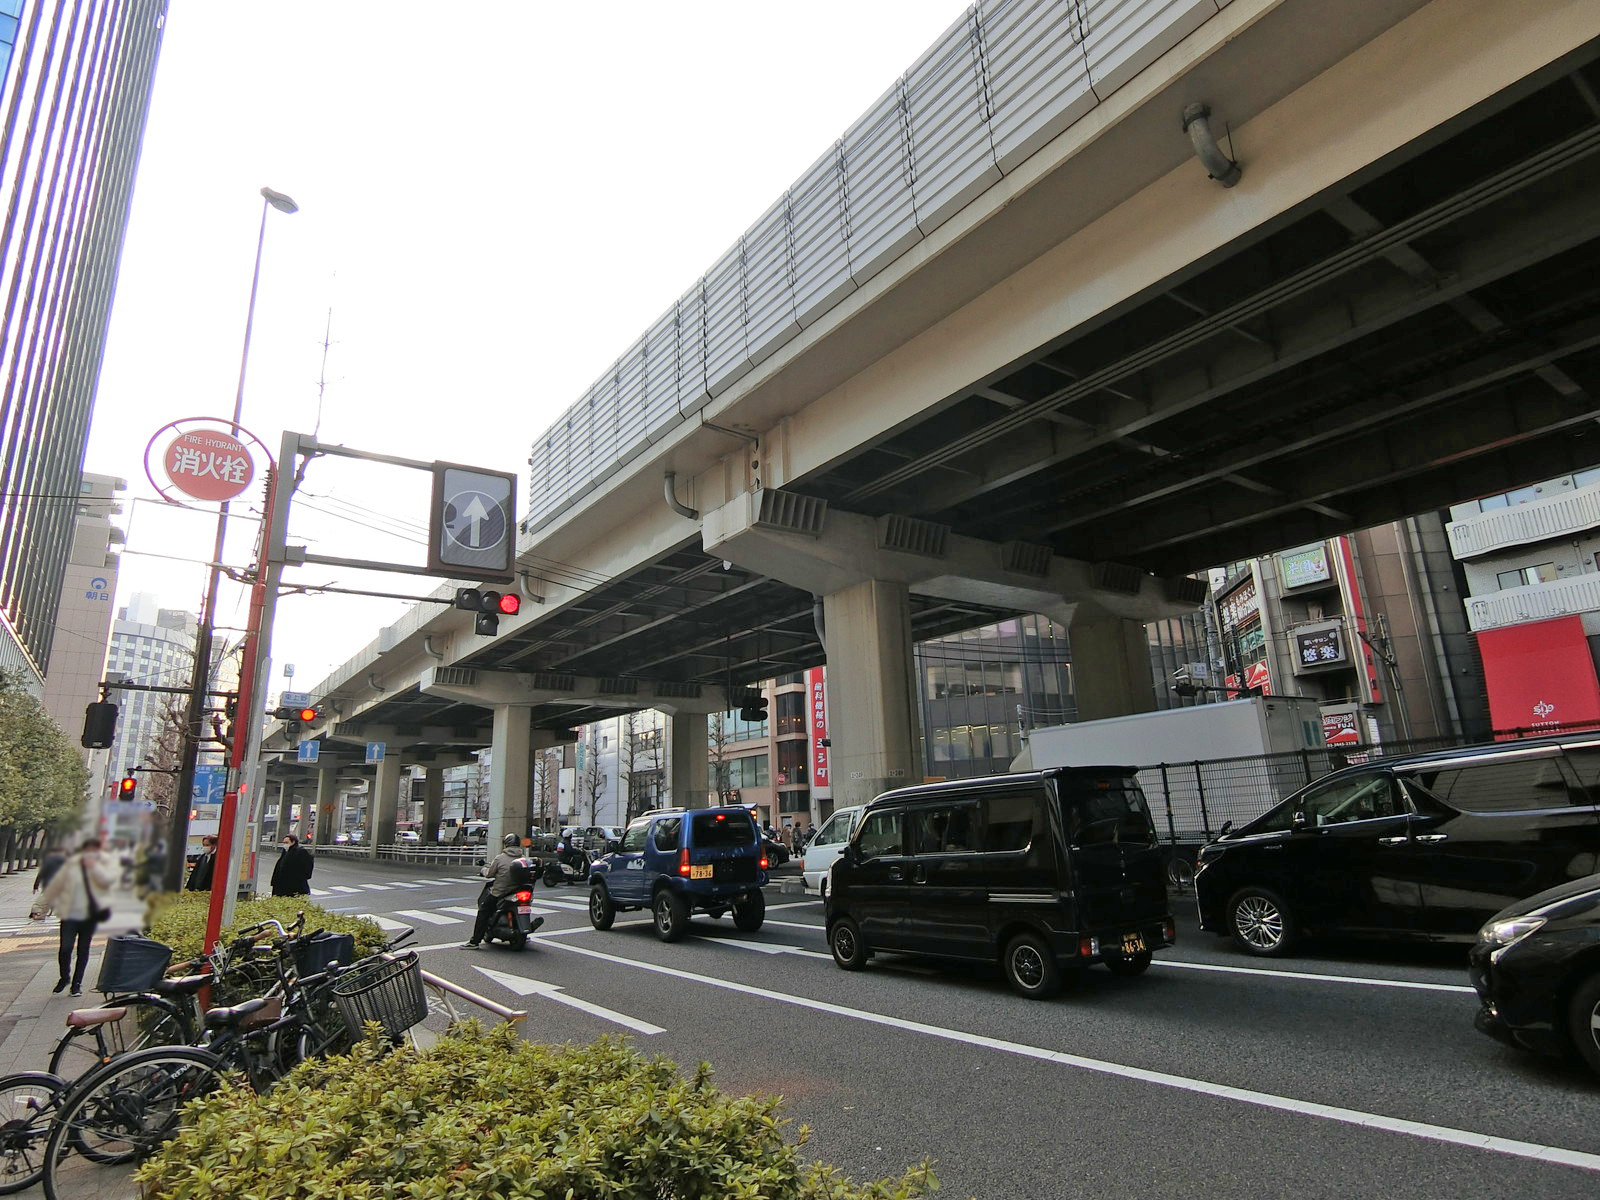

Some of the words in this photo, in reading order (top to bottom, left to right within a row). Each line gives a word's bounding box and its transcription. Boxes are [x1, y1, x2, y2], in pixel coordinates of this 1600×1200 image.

[184, 434, 203, 445] FIRE
[205, 438, 244, 452] HYDRANT
[172, 445, 249, 485] 消火栓
[85, 591, 109, 601] 朝日
[1302, 645, 1336, 662] 悠楽
[814, 682, 825, 729] 歯科機械の
[1531, 720, 1560, 728] SUTTON
